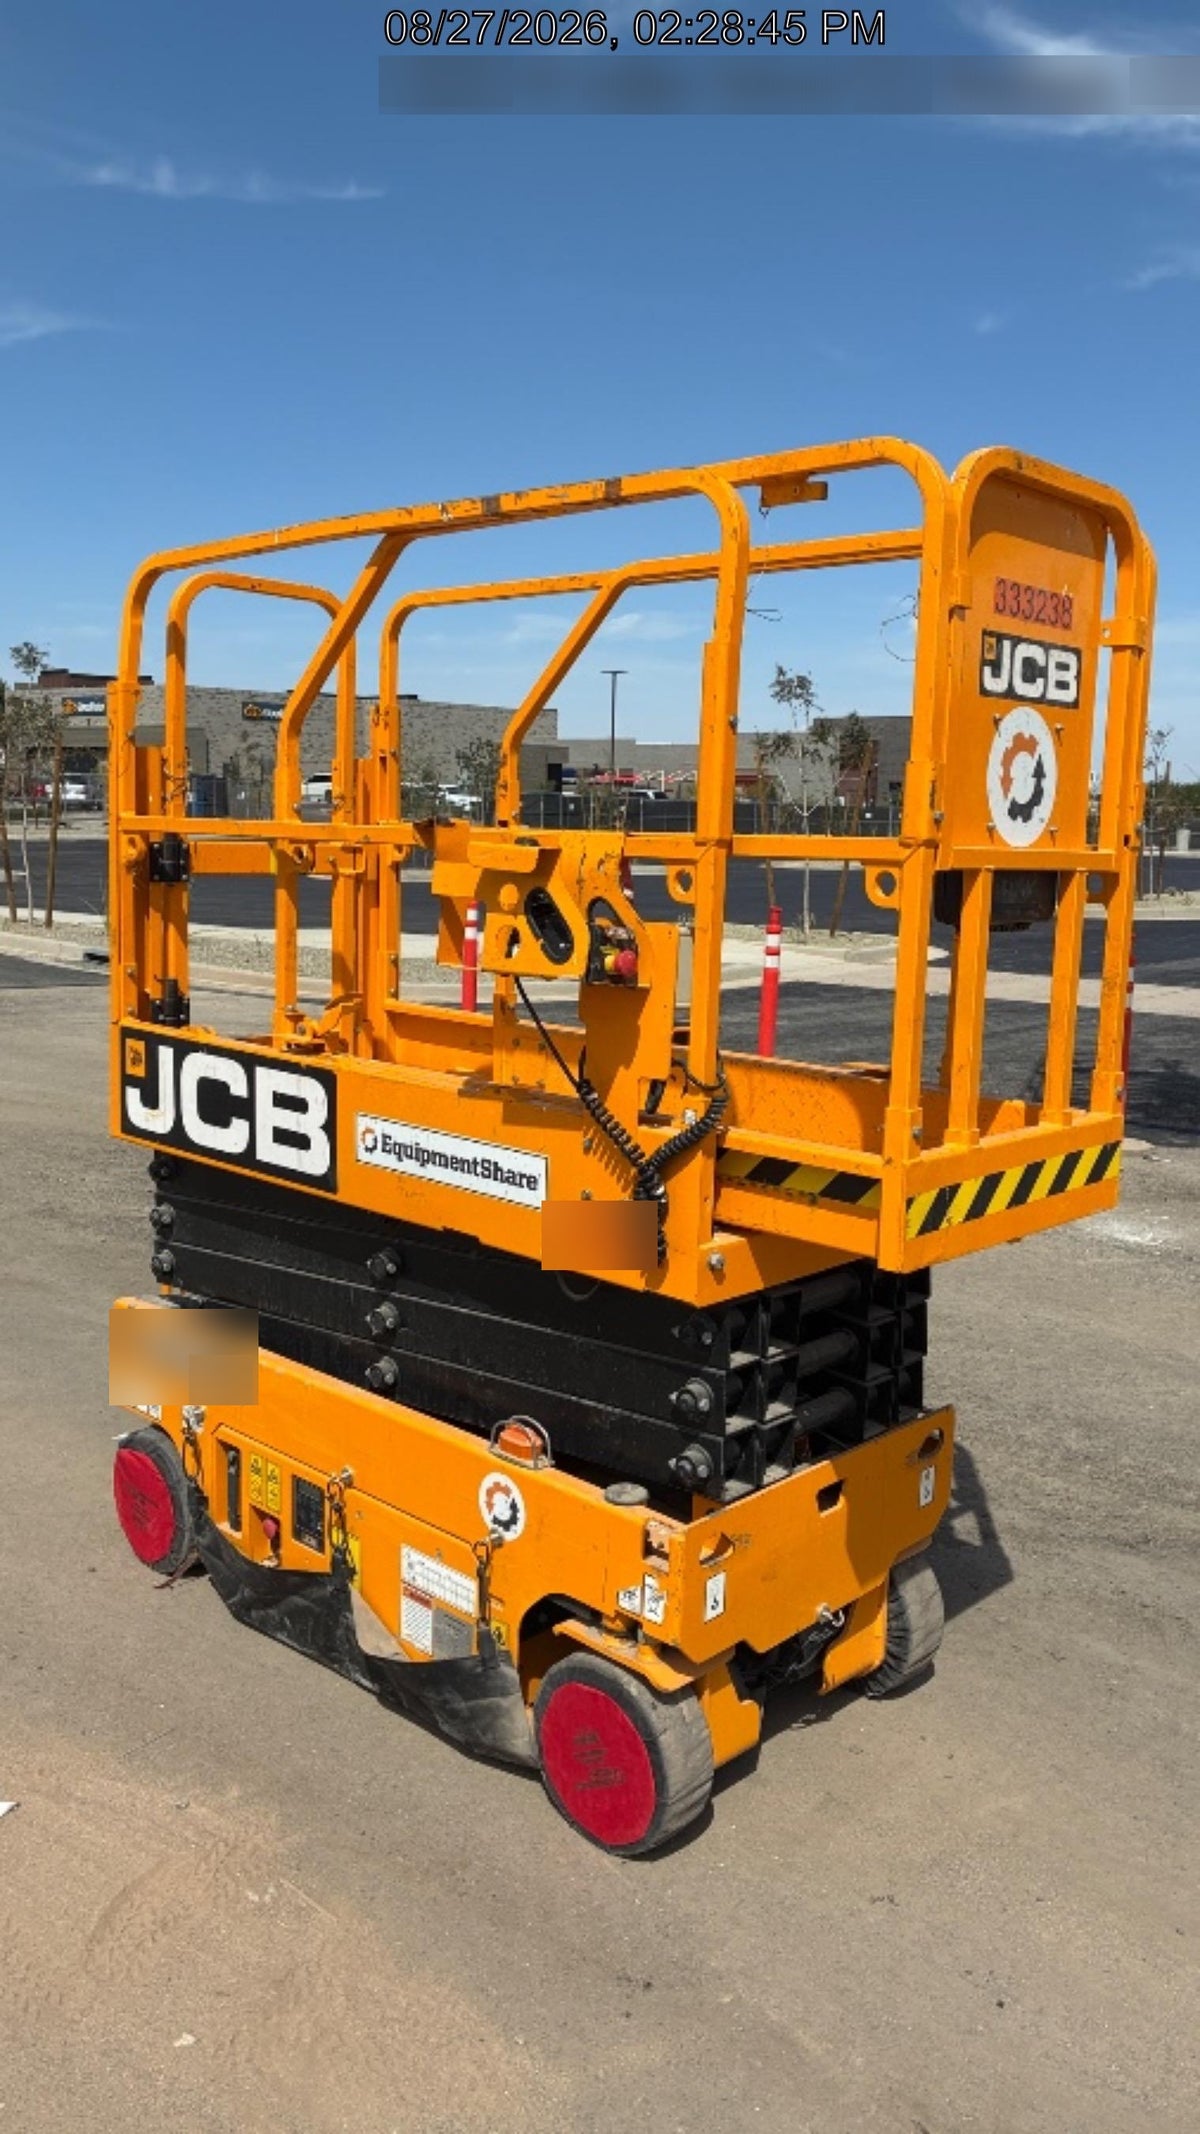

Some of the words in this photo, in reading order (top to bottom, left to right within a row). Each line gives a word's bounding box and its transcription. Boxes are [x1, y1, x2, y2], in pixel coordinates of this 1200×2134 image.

[995, 578, 1073, 630] 333238
[983, 639, 1078, 703] JCB
[125, 1045, 331, 1177] JCB
[381, 1133, 538, 1191] EquipmentShare
